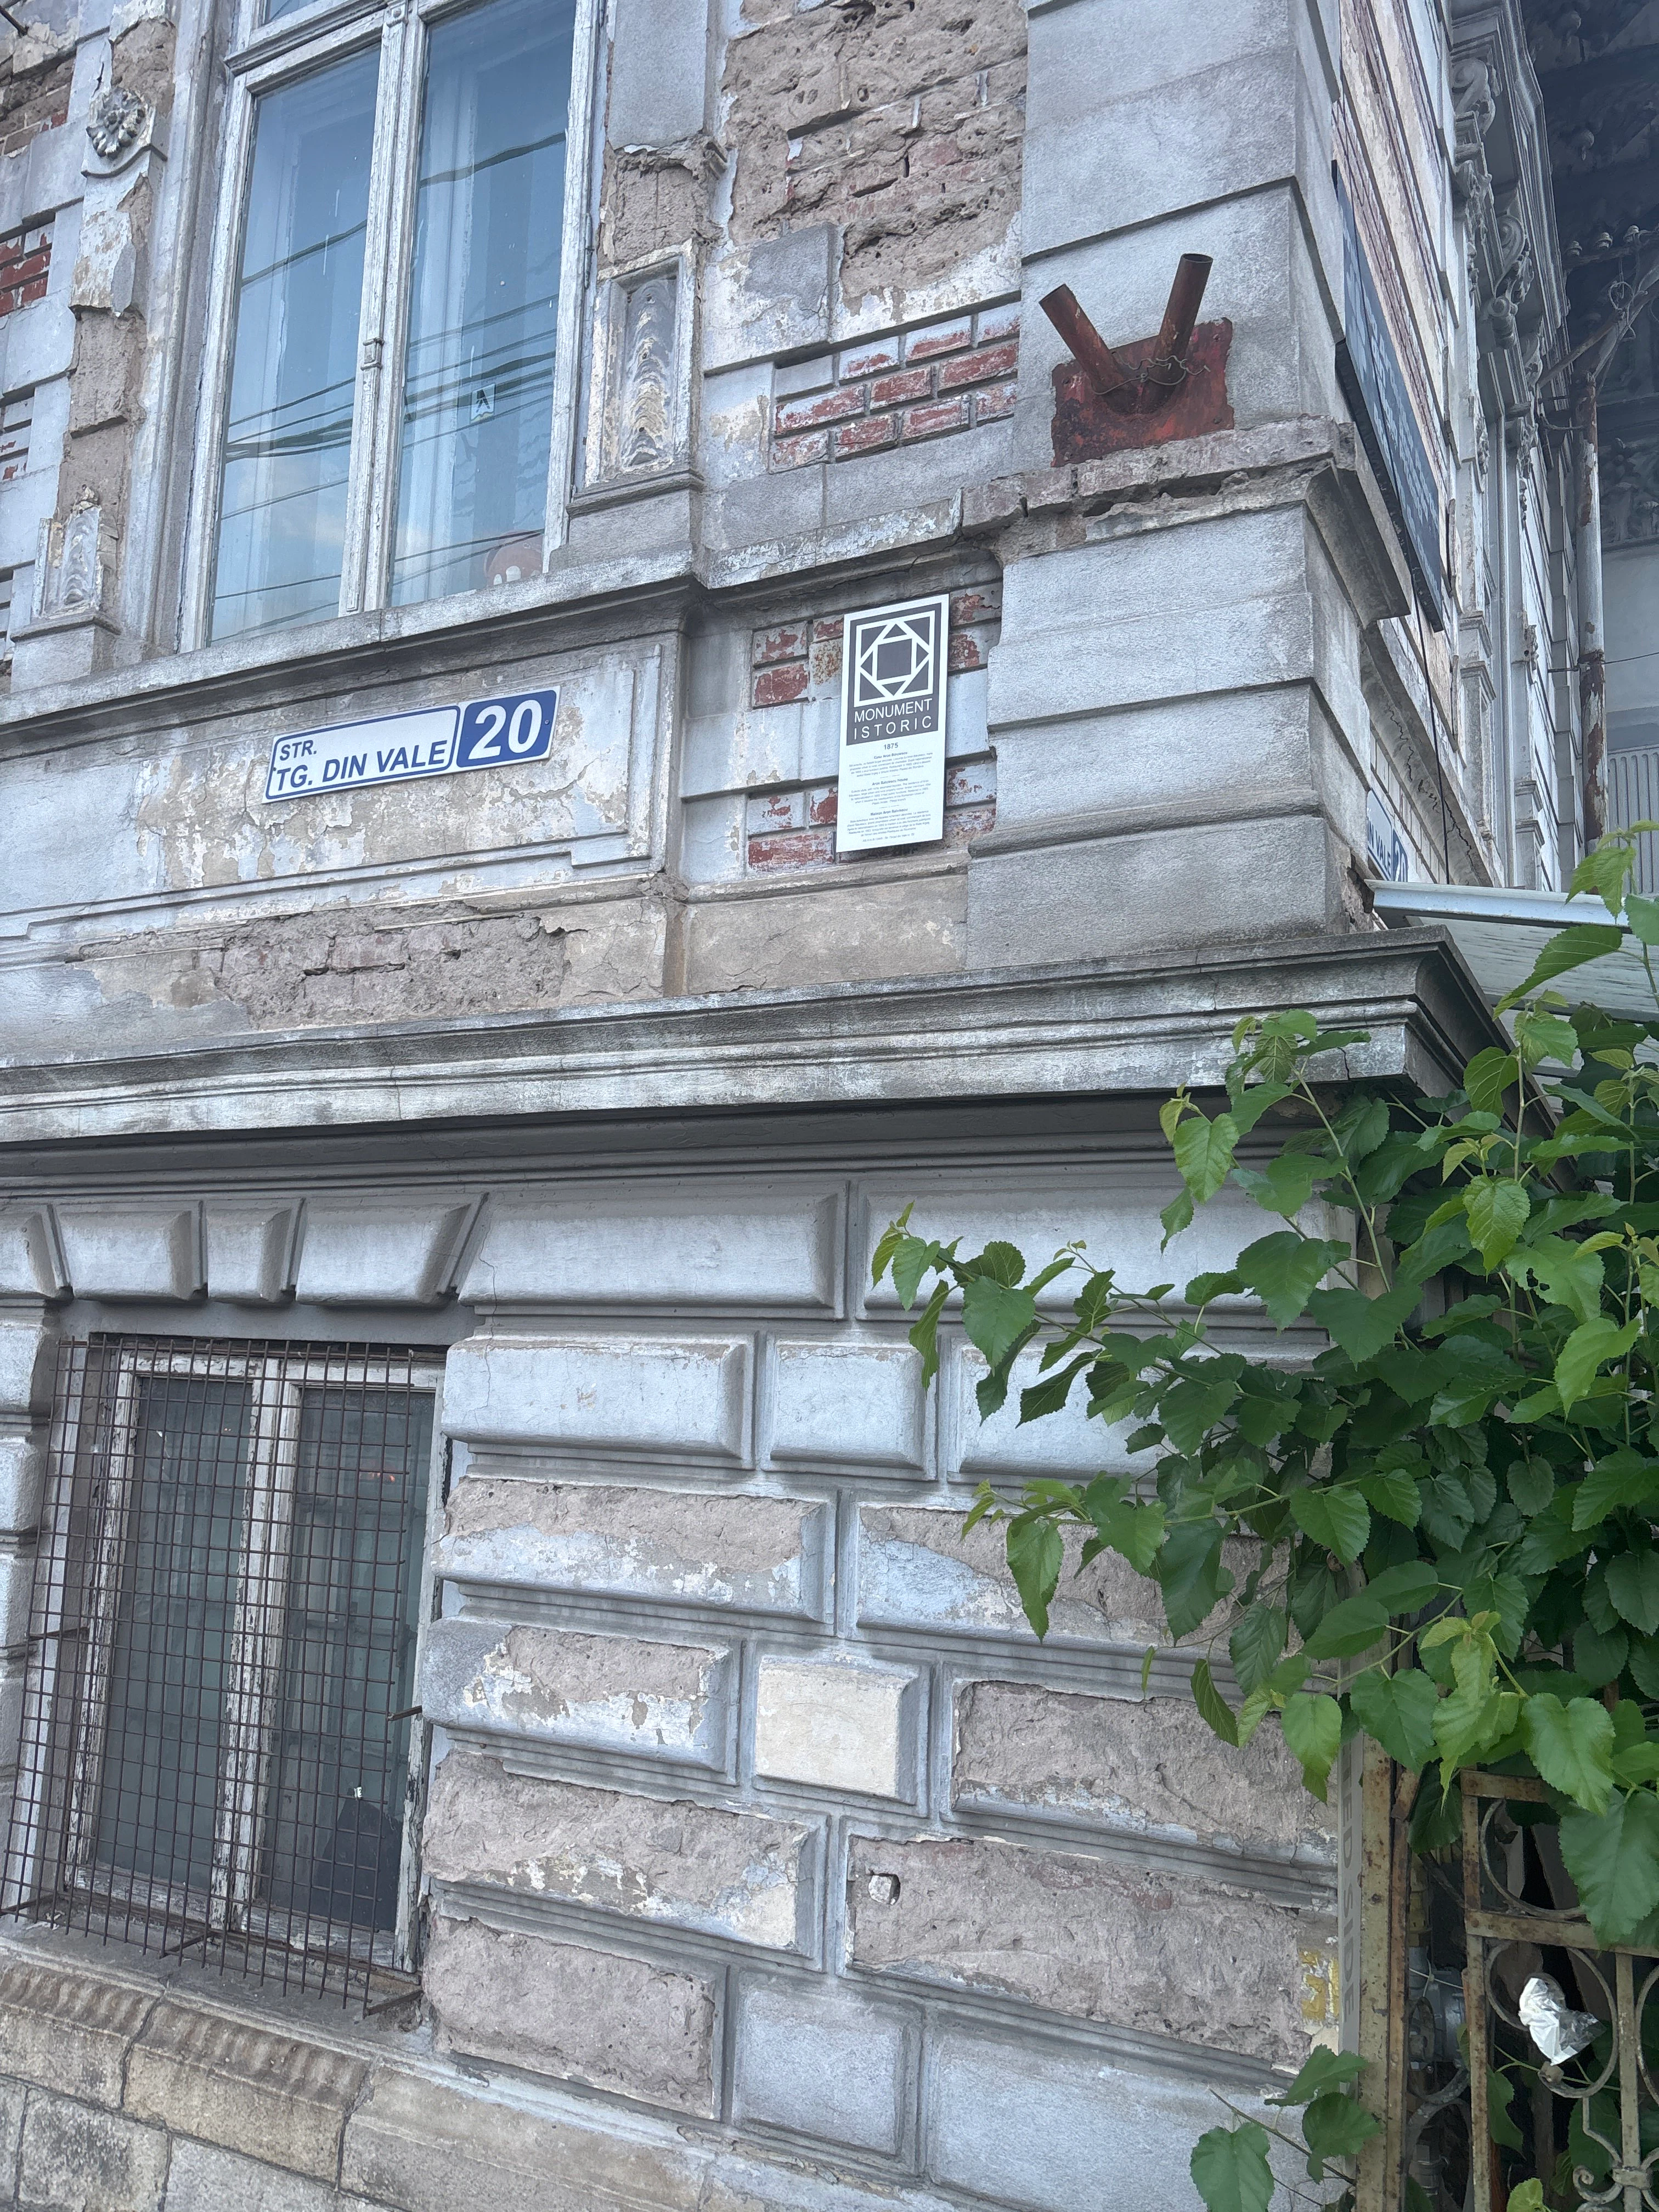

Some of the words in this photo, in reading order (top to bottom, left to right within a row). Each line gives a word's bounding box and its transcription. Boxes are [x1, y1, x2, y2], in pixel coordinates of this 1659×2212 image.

[468, 699, 543, 760] 20
[854, 698, 933, 723] MONUMENT
[854, 715, 932, 740] ISTORIC
[276, 765, 312, 791] TG.
[322, 753, 367, 782] DIN
[377, 740, 448, 772] VALE
[280, 740, 317, 761] STR.
[1376, 830, 1391, 877] VALE
[1395, 840, 1407, 882] 20
